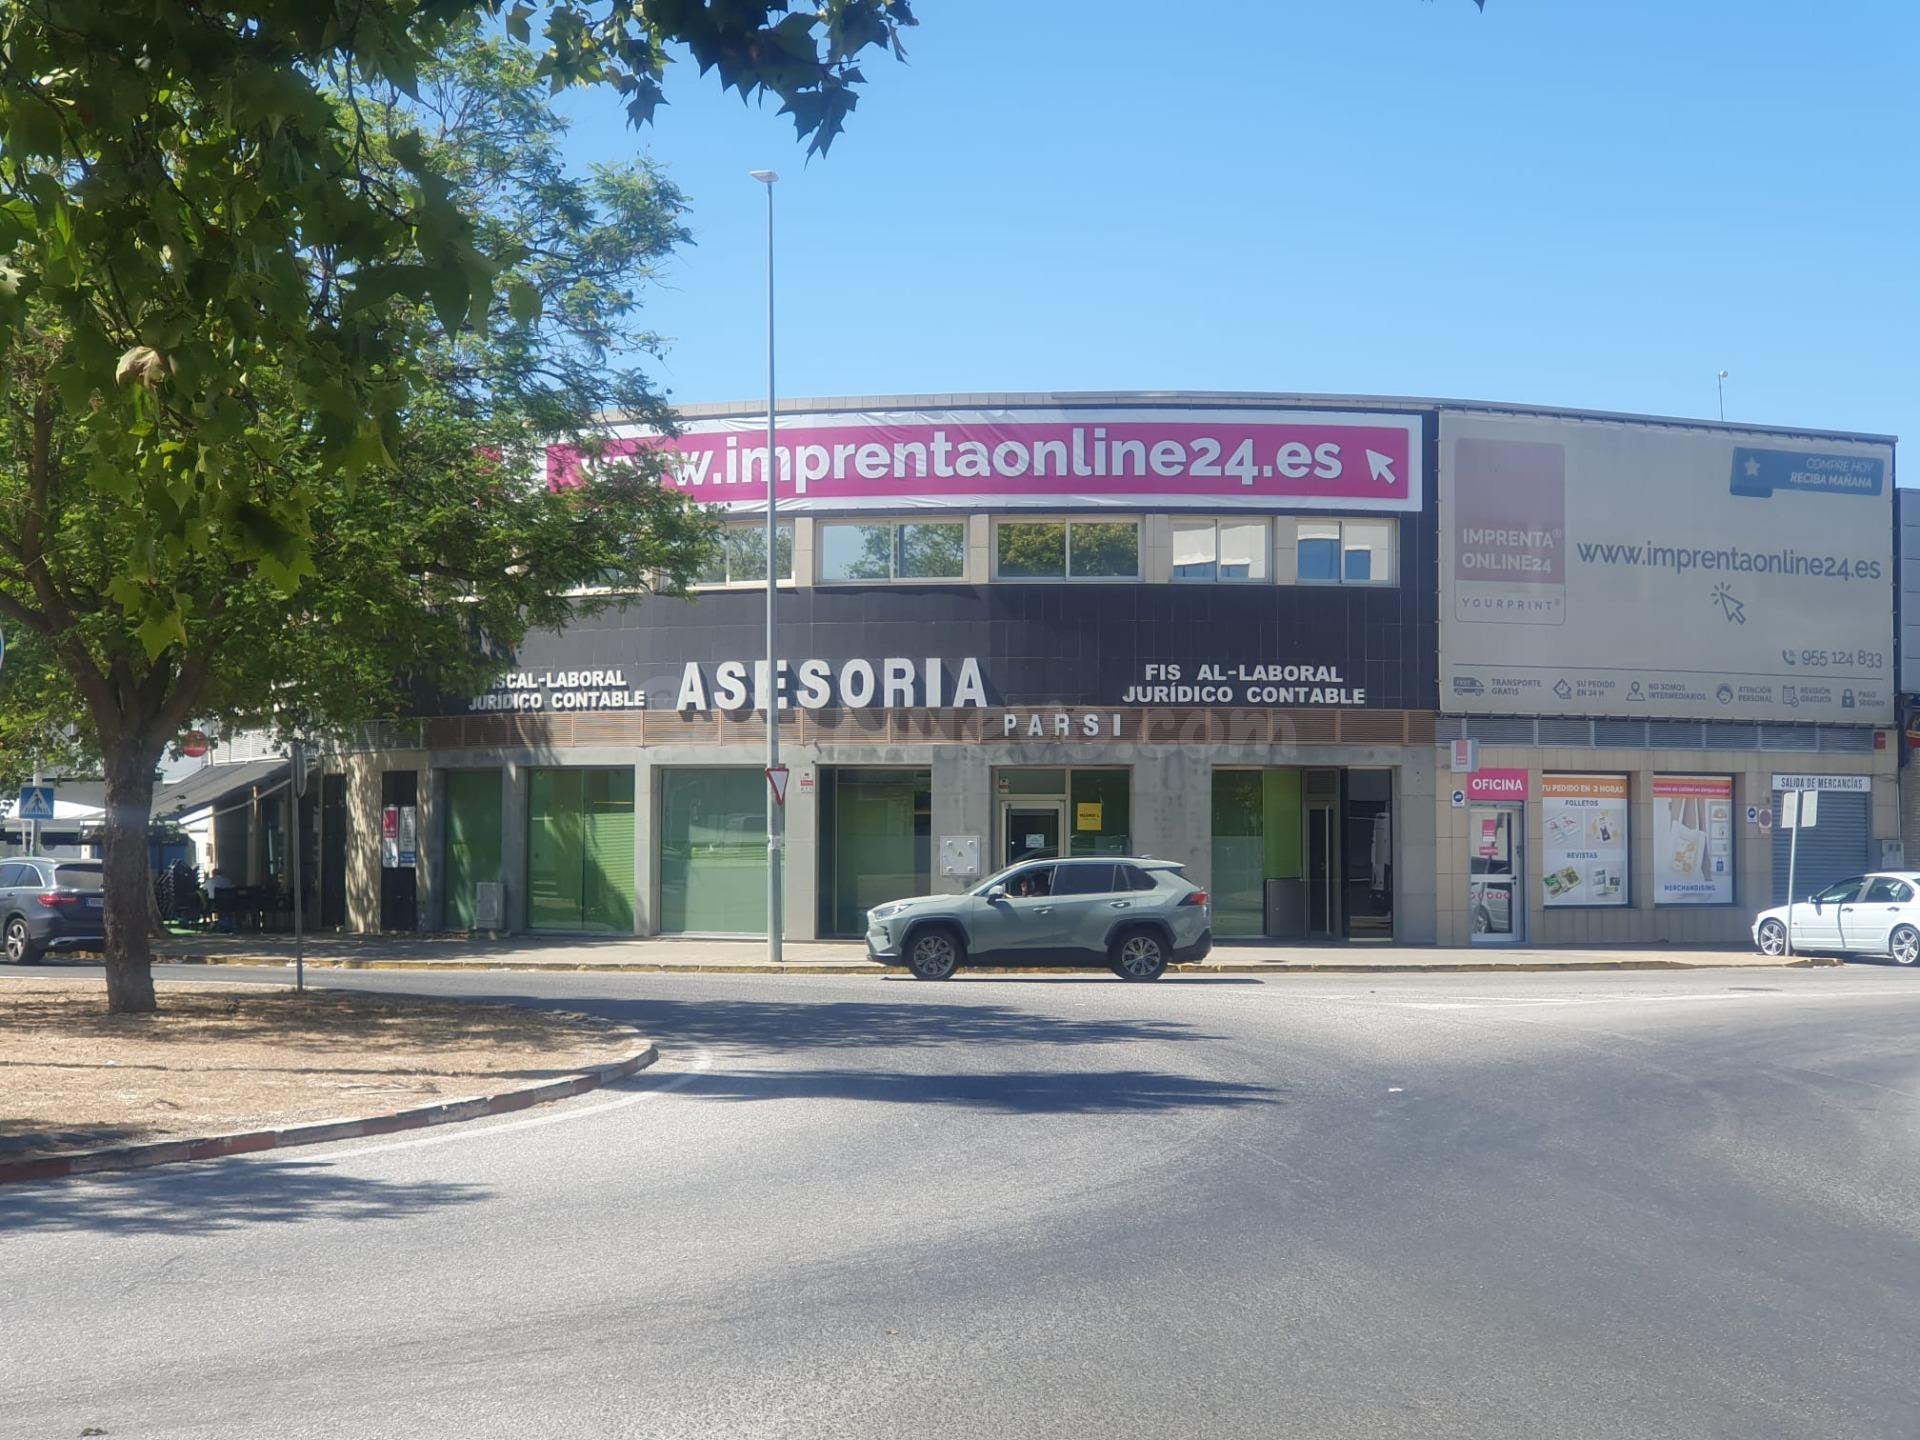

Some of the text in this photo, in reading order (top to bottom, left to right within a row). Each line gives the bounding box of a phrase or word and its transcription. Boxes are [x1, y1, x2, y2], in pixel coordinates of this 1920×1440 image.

[1790, 471, 1873, 489] RECIBA MAÑANA
[1462, 551, 1552, 575] ONLINE24
[1577, 540, 1882, 582] www.imprentaonline24.es
[1801, 649, 1883, 669] 955 124 833
[1145, 663, 1344, 682] FIS AL-LABORAL
[675, 656, 988, 711] ASESORIA
[1491, 678, 1542, 688] TRANSPORTE
[1491, 687, 1520, 696] GRATIS
[1588, 679, 1616, 689] PEDIDO
[551, 689, 646, 708] CONTABLE
[1122, 682, 1366, 704] JURÍDICO CONTABLE
[1004, 713, 1122, 738] PARSI
[1472, 778, 1524, 792] OFICINA
[1552, 784, 1580, 793] PEDIDO
[1780, 777, 1863, 790] SALIDA DE MERCANCÍAS
[1564, 799, 1599, 807] FOLLETOS
[1664, 883, 1716, 892] MERCHANDISING
